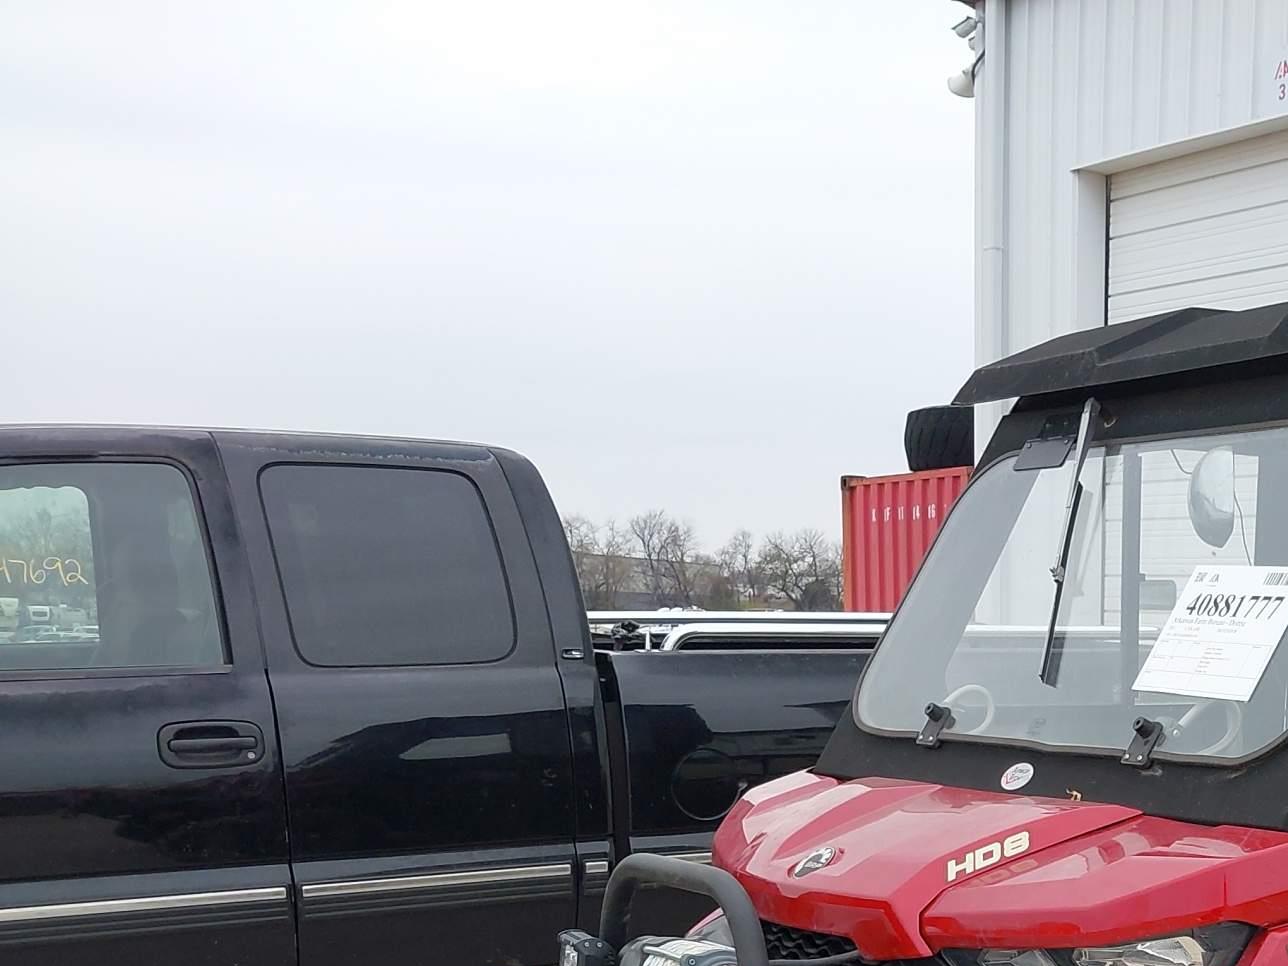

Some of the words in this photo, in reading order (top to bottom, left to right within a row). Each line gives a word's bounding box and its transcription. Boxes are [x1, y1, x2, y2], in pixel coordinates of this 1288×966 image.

[1279, 83, 1286, 101] 3
[1186, 593, 1286, 620] 40881777
[947, 831, 1030, 882] HD8
